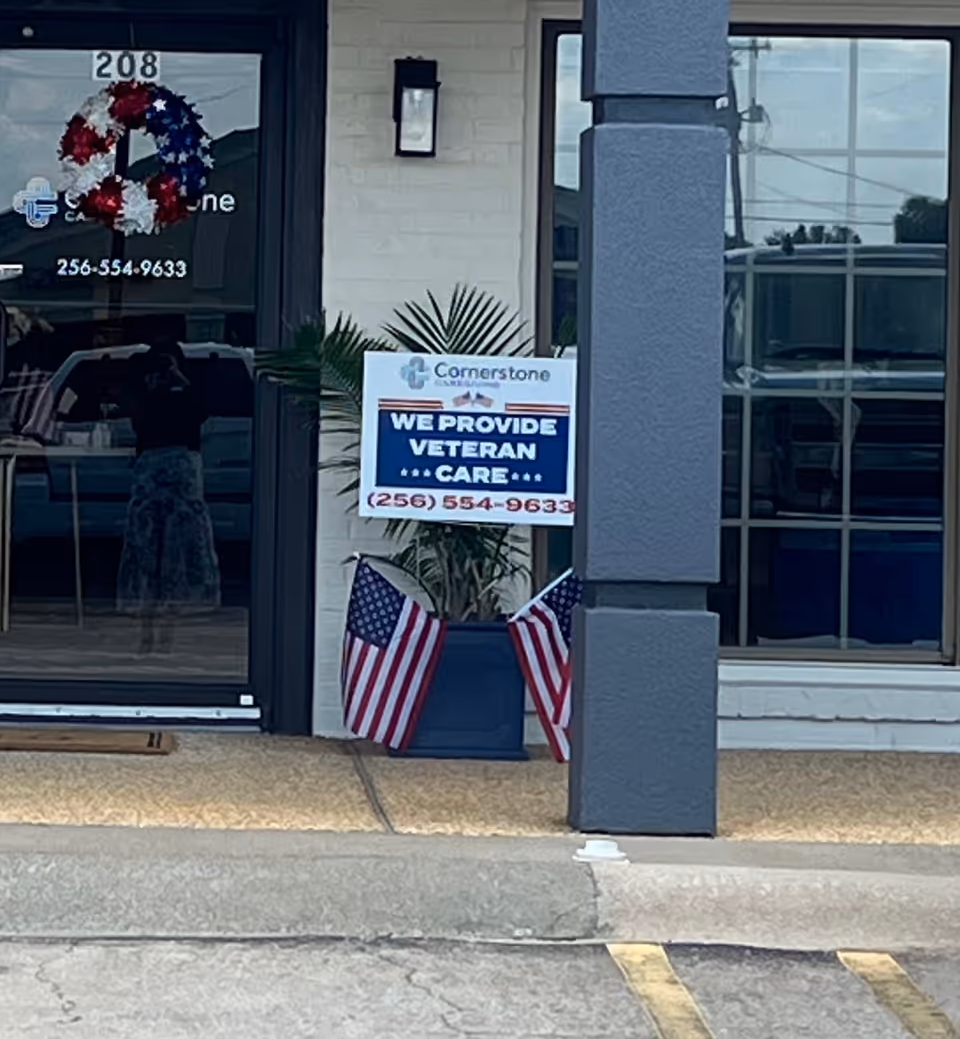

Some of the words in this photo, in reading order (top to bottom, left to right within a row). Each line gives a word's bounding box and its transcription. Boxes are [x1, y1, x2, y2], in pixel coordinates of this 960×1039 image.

[96, 51, 158, 79] 208
[434, 362, 550, 382] Cornerstone
[390, 412, 434, 431] WE
[438, 415, 557, 435] PROVIDE
[409, 439, 536, 460] VETERAN
[435, 465, 509, 484] CARE
[367, 492, 436, 511] (256)
[442, 495, 575, 513] 554-9633
